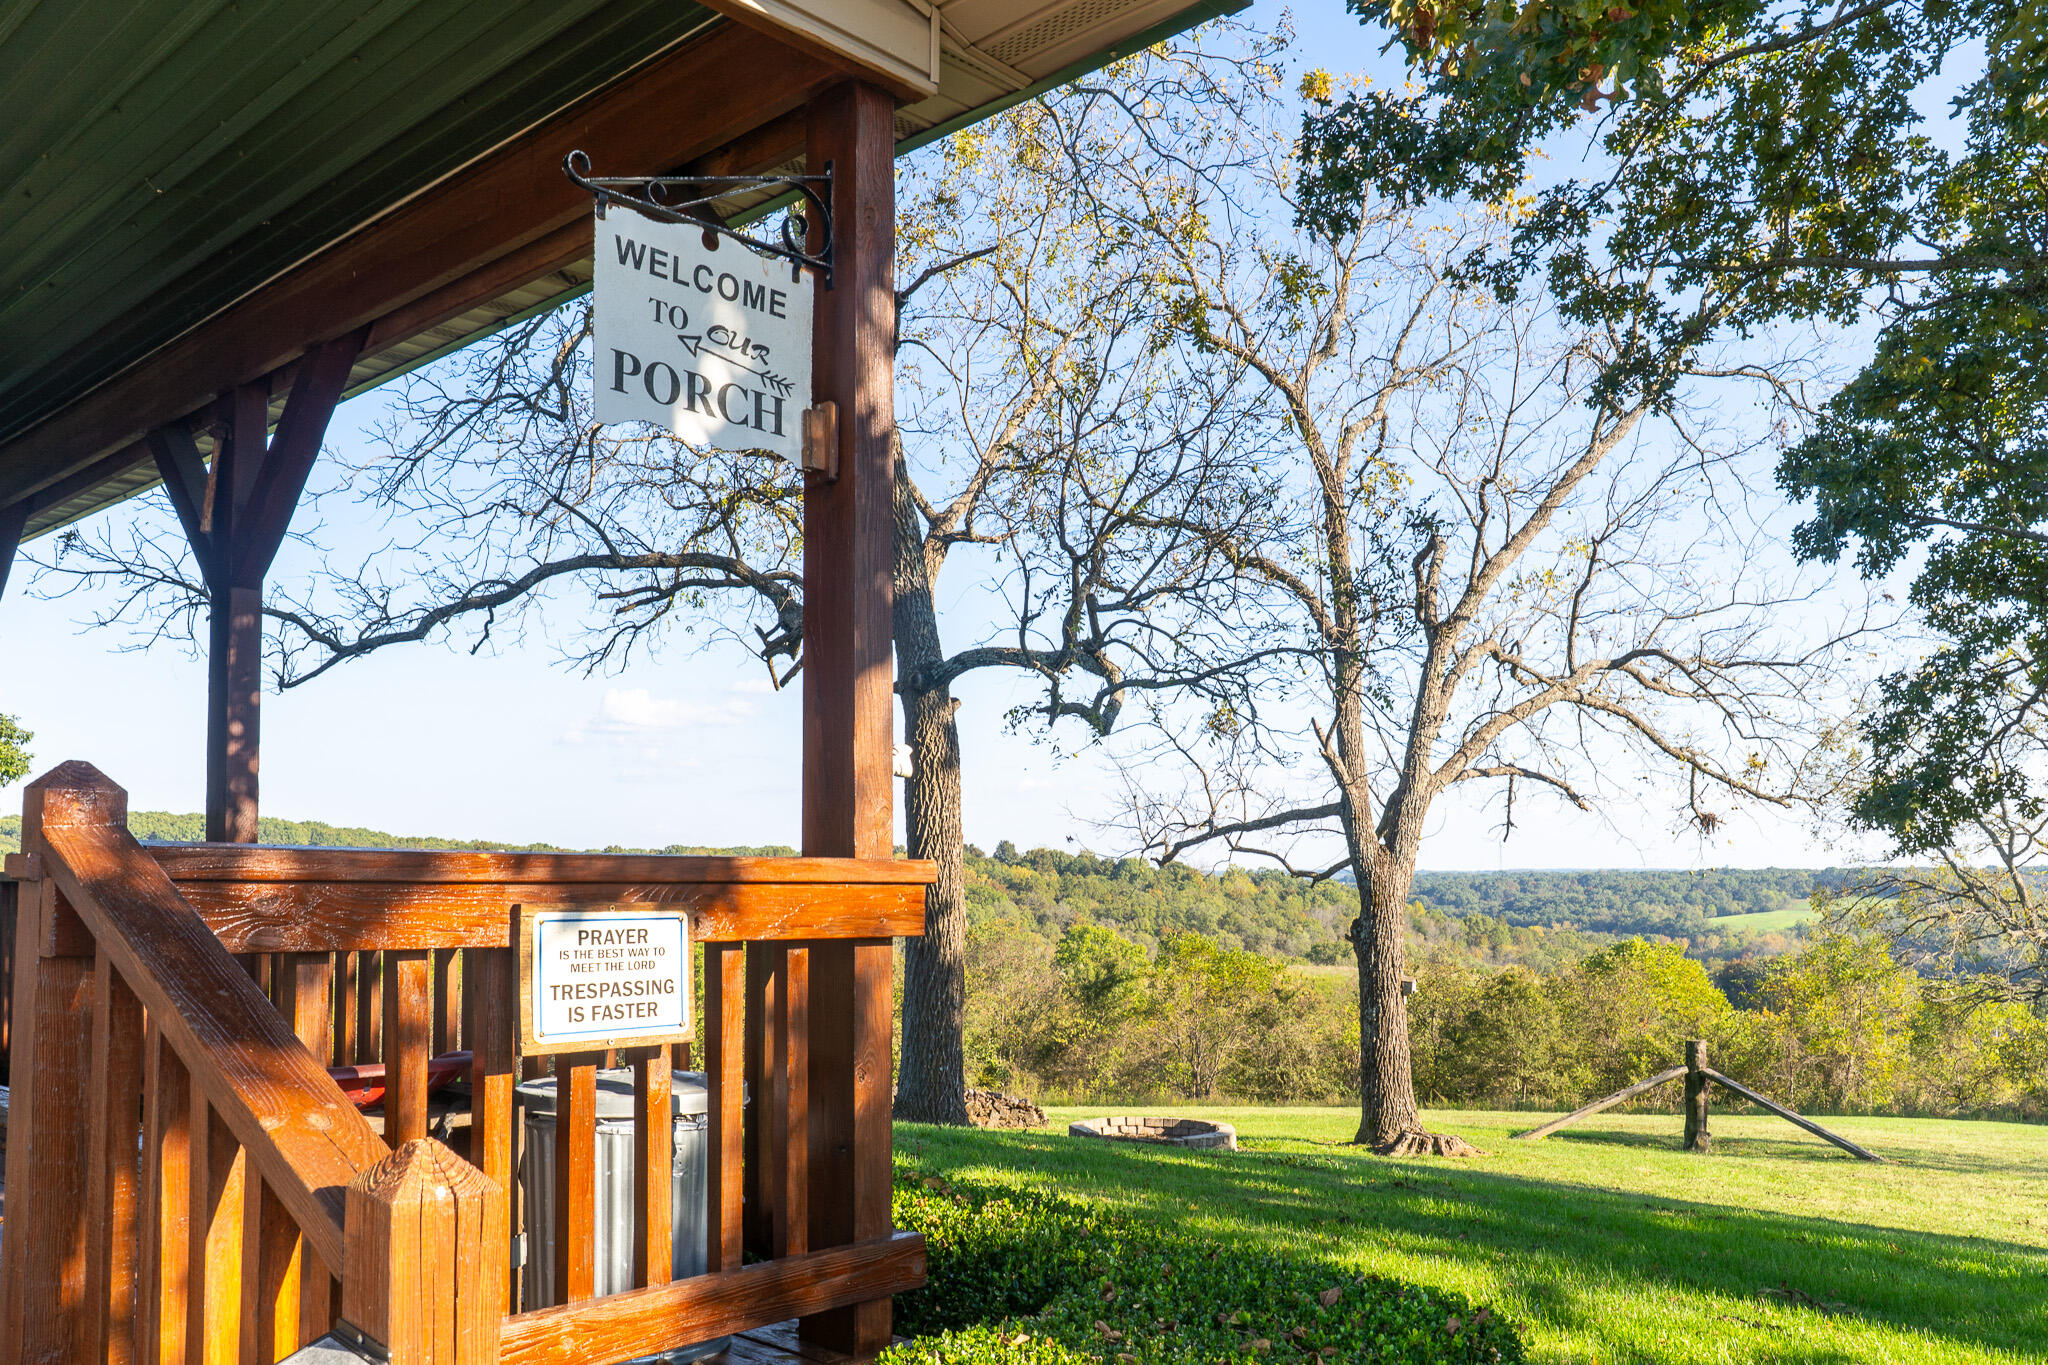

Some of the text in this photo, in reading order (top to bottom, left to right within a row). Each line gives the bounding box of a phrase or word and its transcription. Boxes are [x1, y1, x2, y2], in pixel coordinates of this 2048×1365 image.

[615, 234, 787, 319] WELCOME
[648, 297, 689, 330] TO
[610, 348, 786, 438] PORCH
[578, 928, 649, 946] PRAYER
[559, 947, 666, 960] IS THE BEST WAY TO
[570, 960, 656, 973] MEET THE LORD
[550, 978, 675, 1001] TRESPASSING
[568, 1001, 658, 1023] IS FASTER
